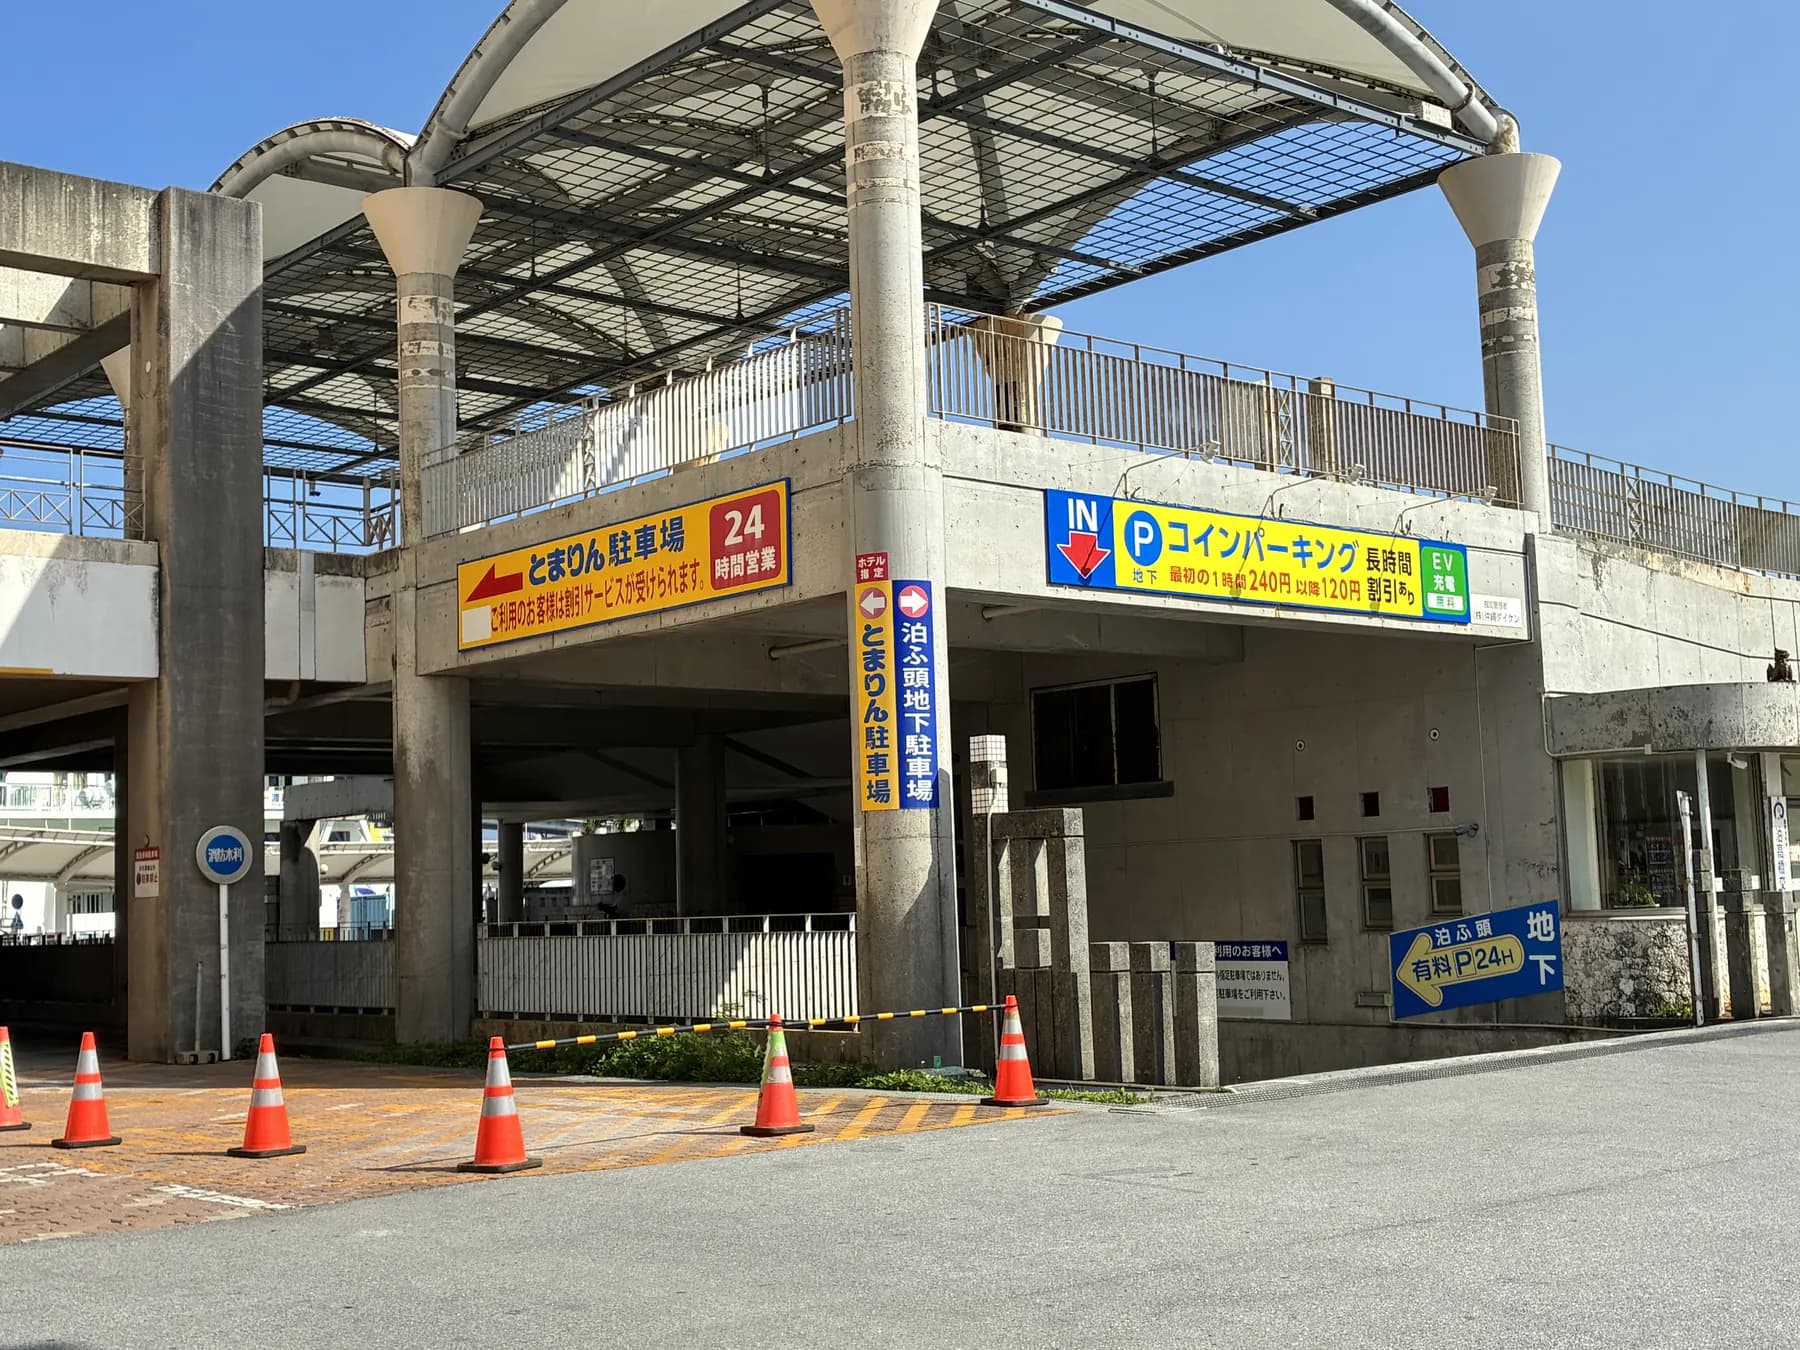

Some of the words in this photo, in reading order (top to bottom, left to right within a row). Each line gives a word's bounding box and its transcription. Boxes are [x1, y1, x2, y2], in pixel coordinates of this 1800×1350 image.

[724, 504, 764, 546] 24
[1068, 498, 1098, 531] IN
[528, 516, 685, 585] とまりん駐車場
[1134, 520, 1154, 557] P
[1168, 520, 1360, 573] コインパーキング
[714, 546, 776, 580] 時間営業
[858, 556, 886, 568] ホテル
[860, 567, 884, 580] 指定
[1133, 568, 1157, 585] 地下
[1366, 547, 1412, 576] 長時間
[1432, 551, 1453, 571] EV
[491, 557, 704, 633] ご利用のお客様は割引サービスが受けられます。
[1367, 577, 1415, 605] 割引あり
[1433, 574, 1456, 592] 充電
[862, 624, 891, 804] とまりん駐車場
[902, 622, 934, 802] 泊ふ頭地下駐車場
[1435, 918, 1492, 947] 泊ふ頭
[1527, 910, 1557, 985] 地下
